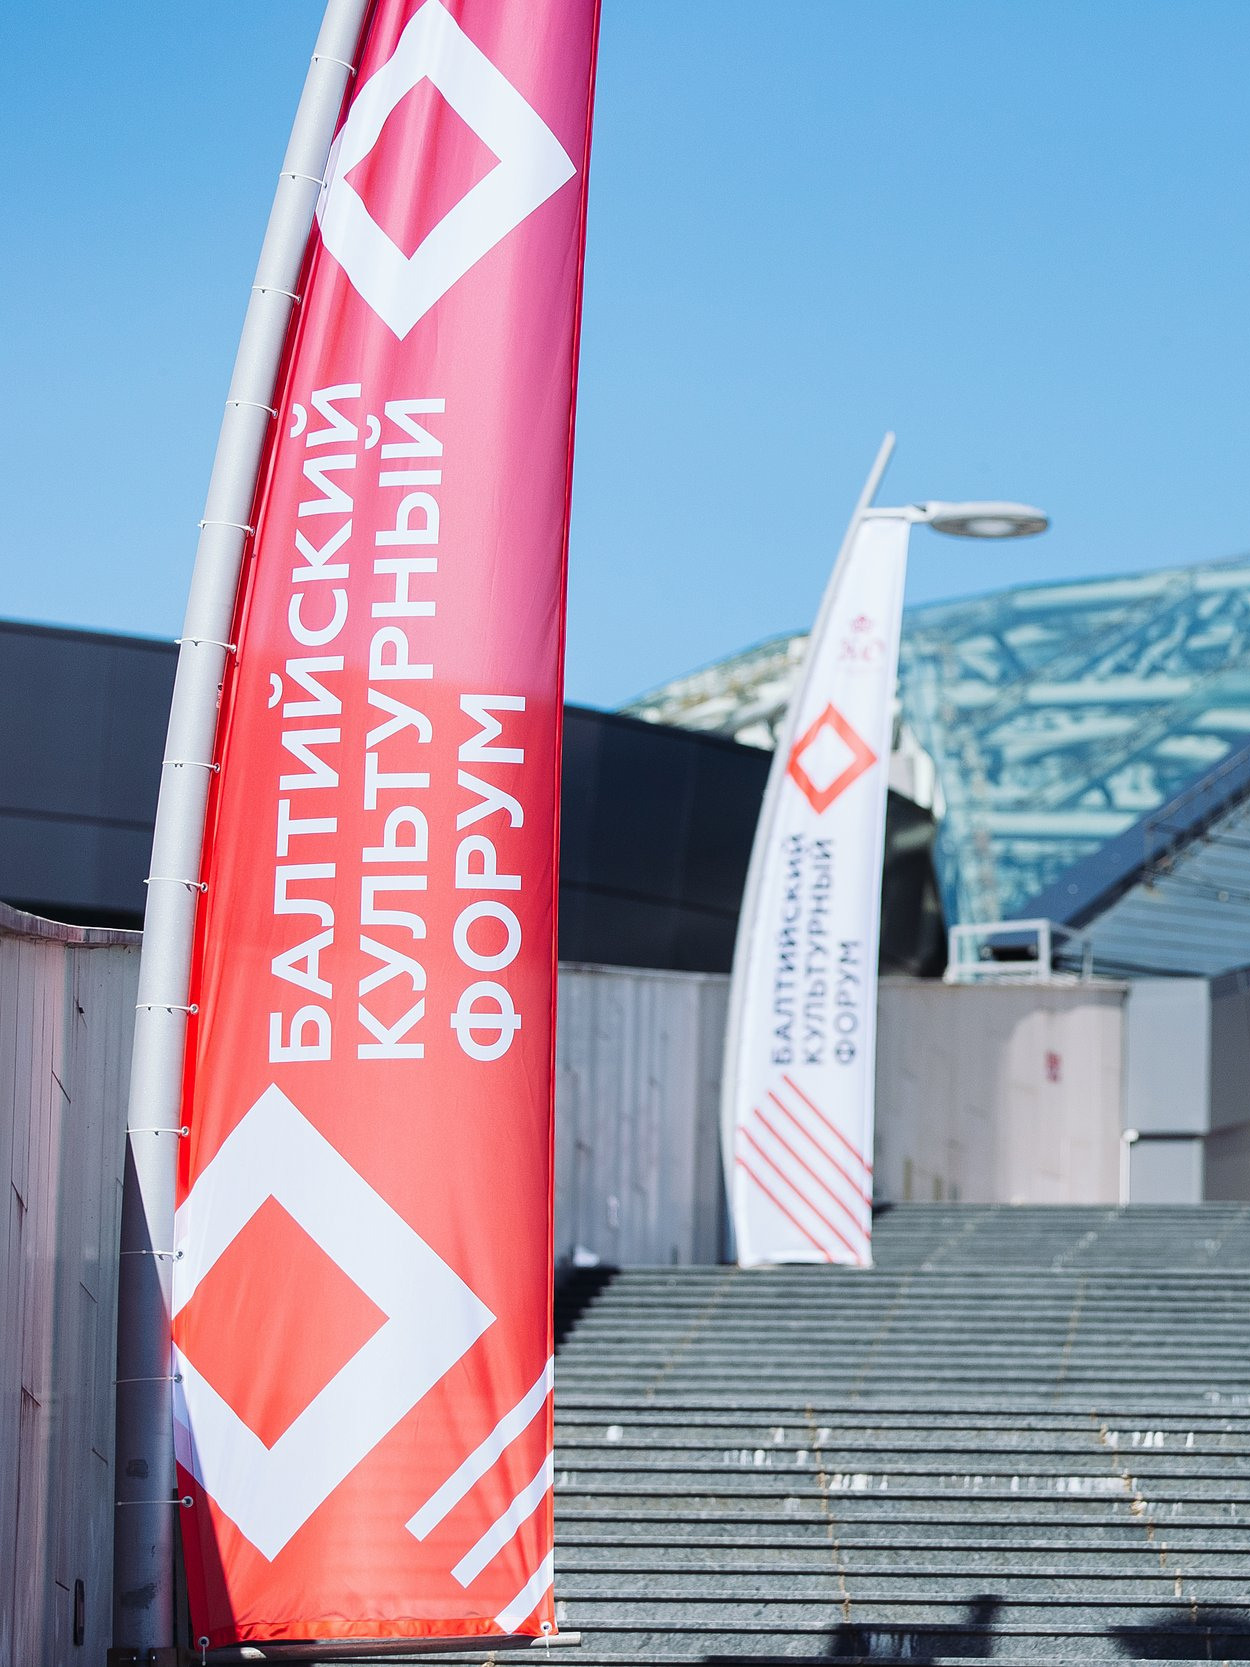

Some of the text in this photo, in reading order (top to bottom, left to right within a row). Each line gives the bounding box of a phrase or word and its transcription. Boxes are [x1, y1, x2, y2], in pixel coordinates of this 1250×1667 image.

[268, 383, 361, 1064] БАЛТИЙСКИЙ
[357, 398, 445, 1060] КУЛЬТУРНЫЙ
[450, 694, 526, 1062] ФОРУМ
[772, 833, 803, 1066] БАЛТИЙСКИЙ
[803, 839, 833, 1065] КУЛЬТУРНЫЙ
[834, 940, 861, 1066] ФОРУМ
